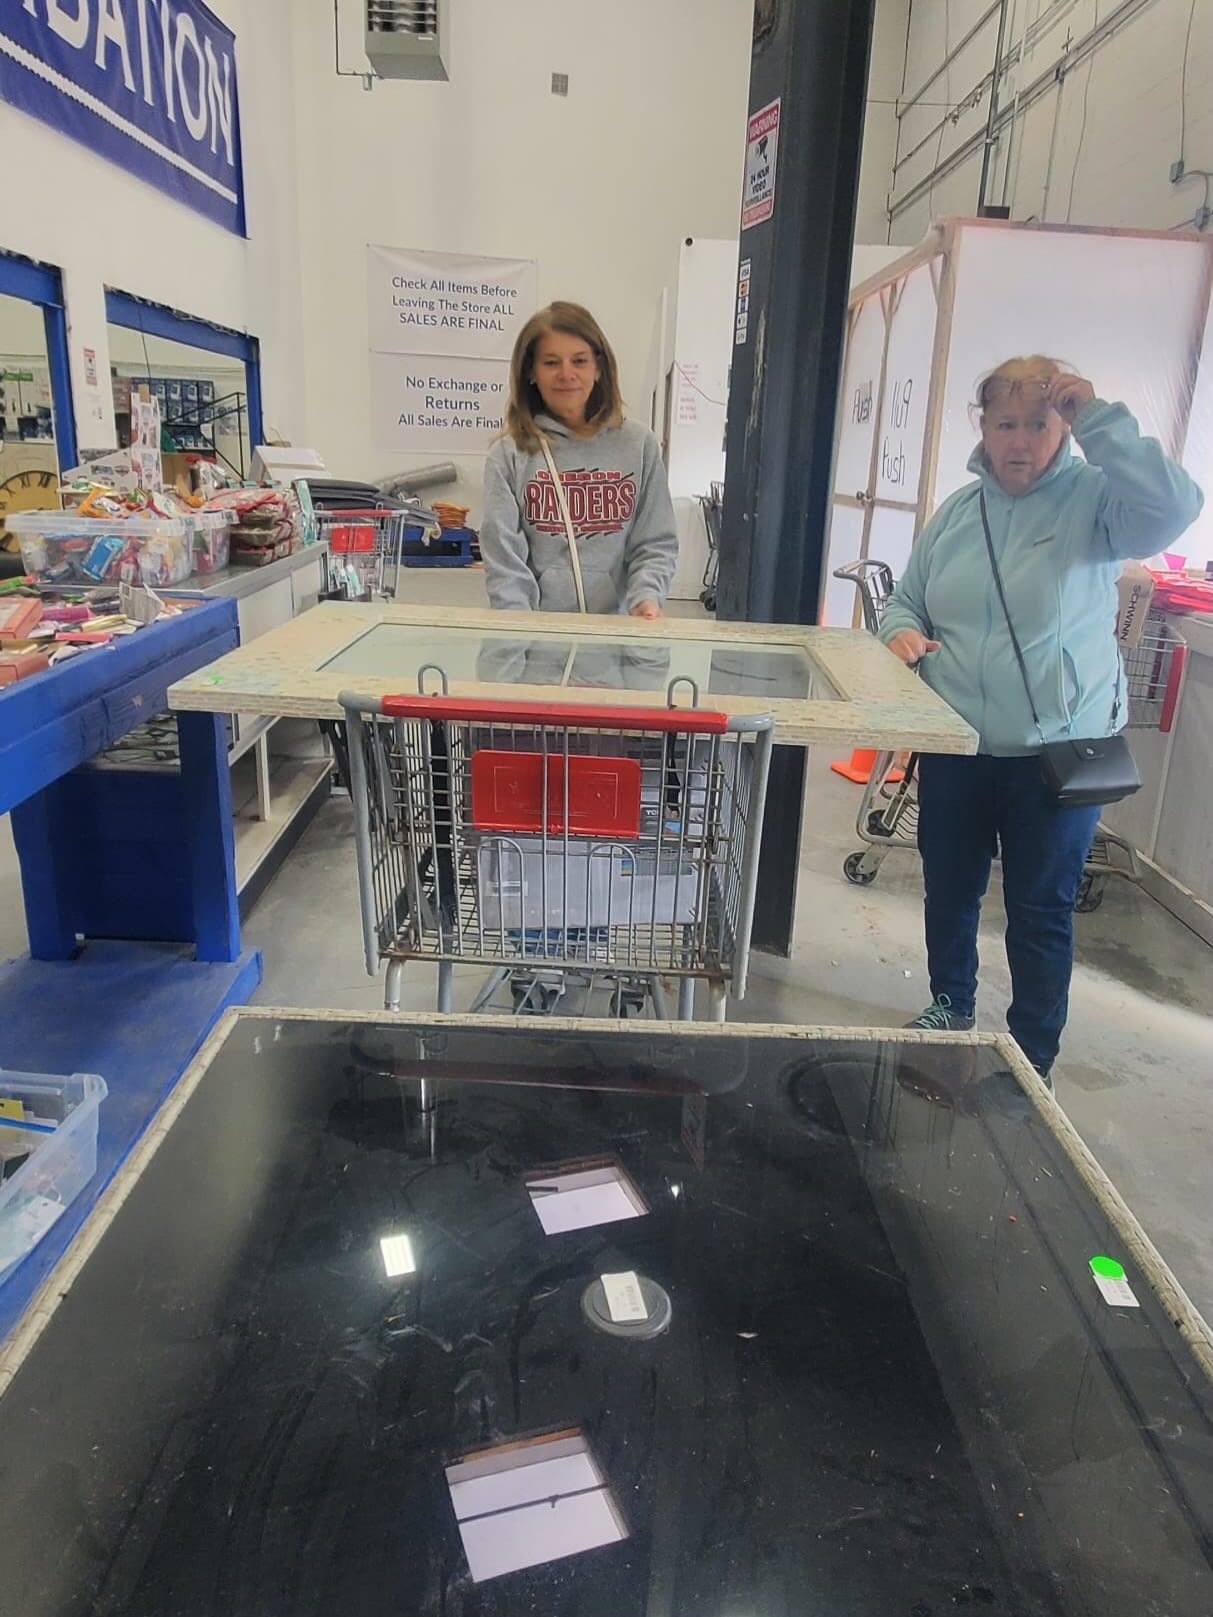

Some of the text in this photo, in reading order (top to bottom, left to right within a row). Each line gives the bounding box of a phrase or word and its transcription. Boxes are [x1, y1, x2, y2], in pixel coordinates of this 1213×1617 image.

[392, 276, 518, 298] Check All Items Before
[392, 295, 515, 316] Leaving The Store ALL
[400, 312, 505, 331] SALES ARE FINAL
[406, 375, 504, 394] No Exchange or
[425, 395, 480, 411] Returns
[398, 413, 503, 429] All Sales Are Final
[881, 436, 905, 486] Push
[1120, 584, 1142, 641] SCHWINN
